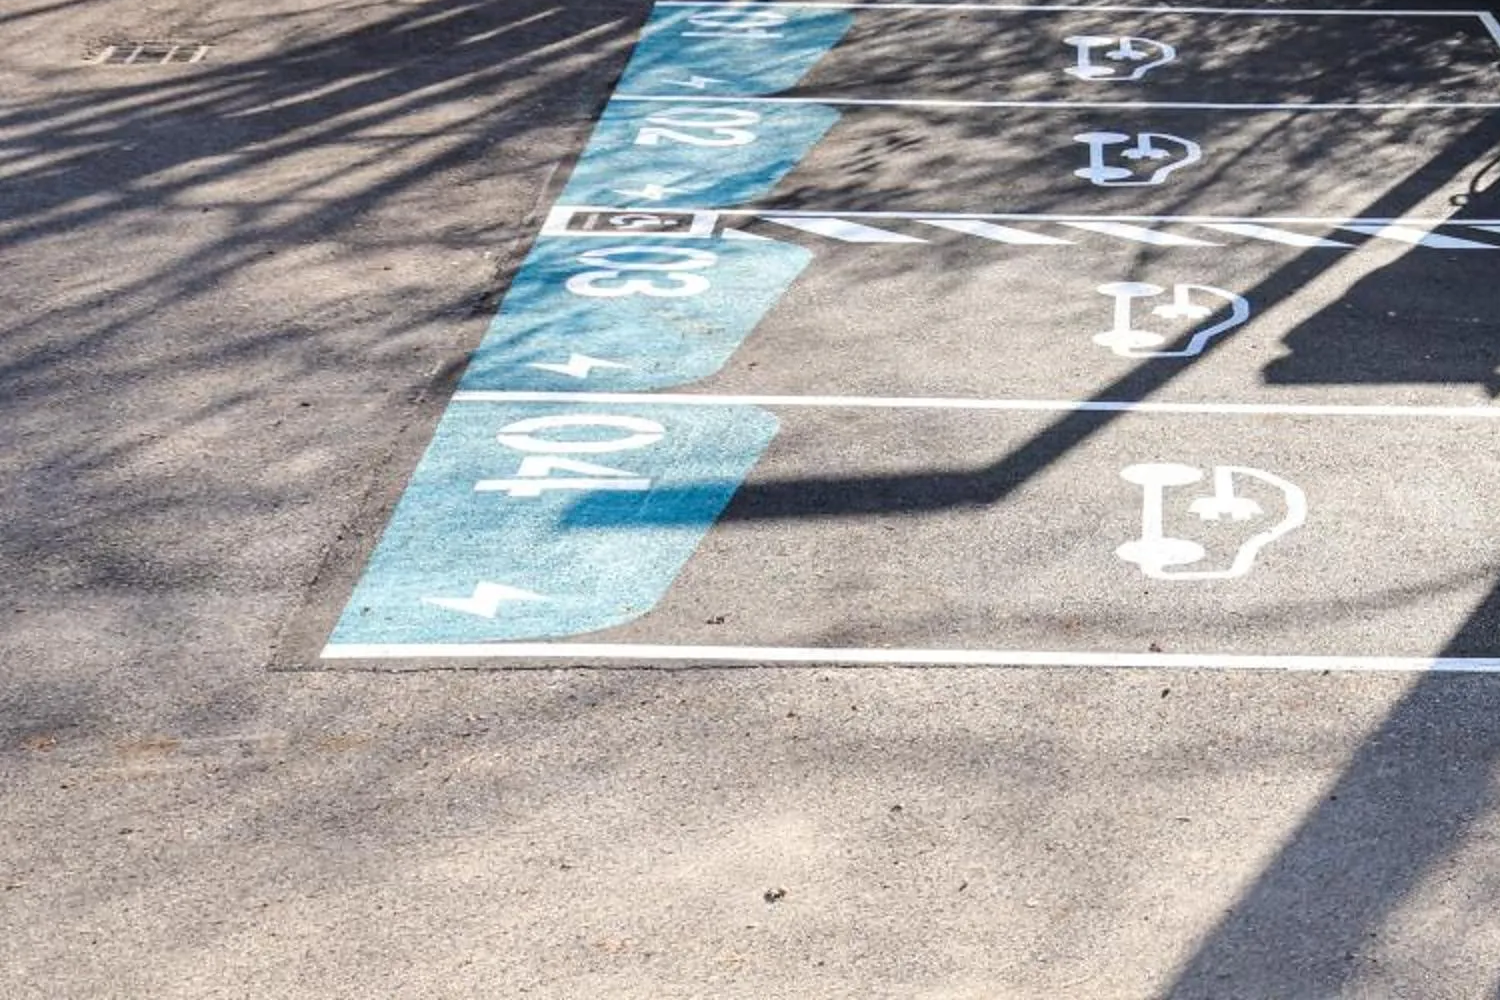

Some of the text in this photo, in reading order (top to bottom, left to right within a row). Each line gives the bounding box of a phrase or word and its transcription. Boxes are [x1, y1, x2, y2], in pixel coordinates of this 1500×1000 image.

[681, 10, 788, 38] 01
[635, 107, 757, 148] 02
[565, 246, 715, 298] 03
[473, 413, 666, 497] 04
